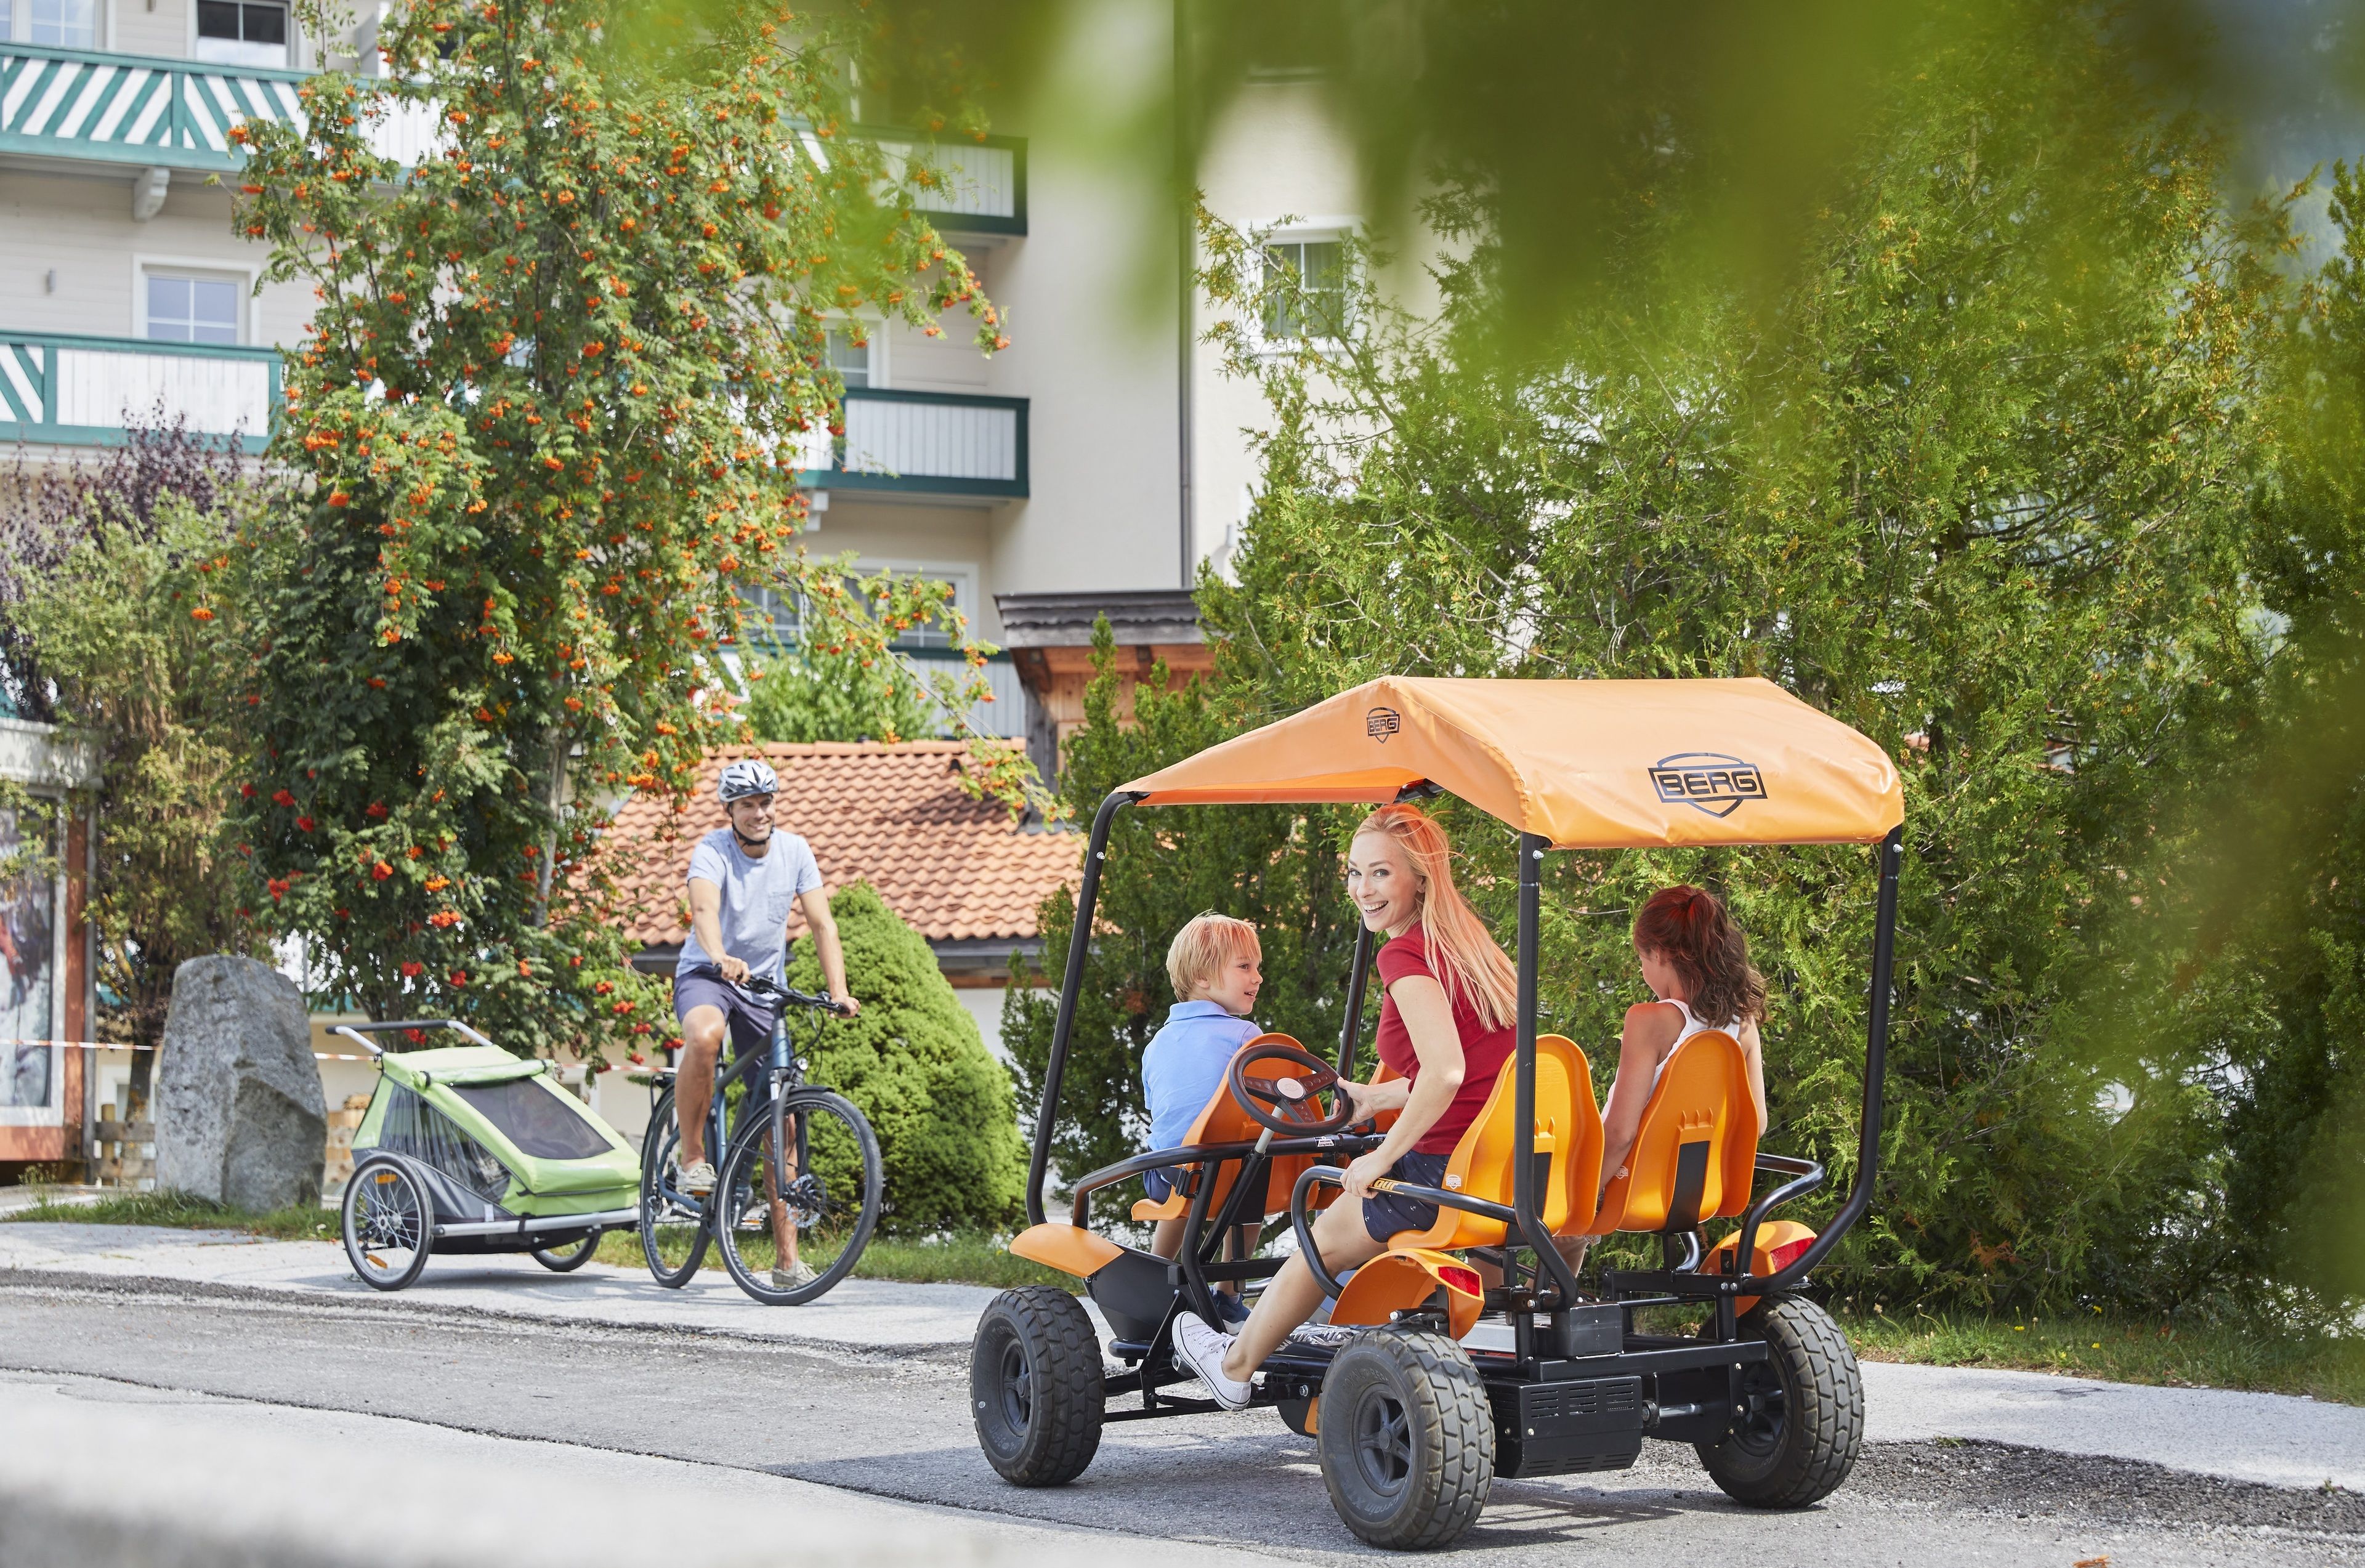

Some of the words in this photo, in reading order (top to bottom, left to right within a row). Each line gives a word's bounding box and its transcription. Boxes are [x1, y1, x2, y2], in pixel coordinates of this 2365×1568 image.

[1368, 717, 1397, 732] BERG
[1657, 770, 1757, 796] BERG
[1370, 1179, 1399, 1190] our
